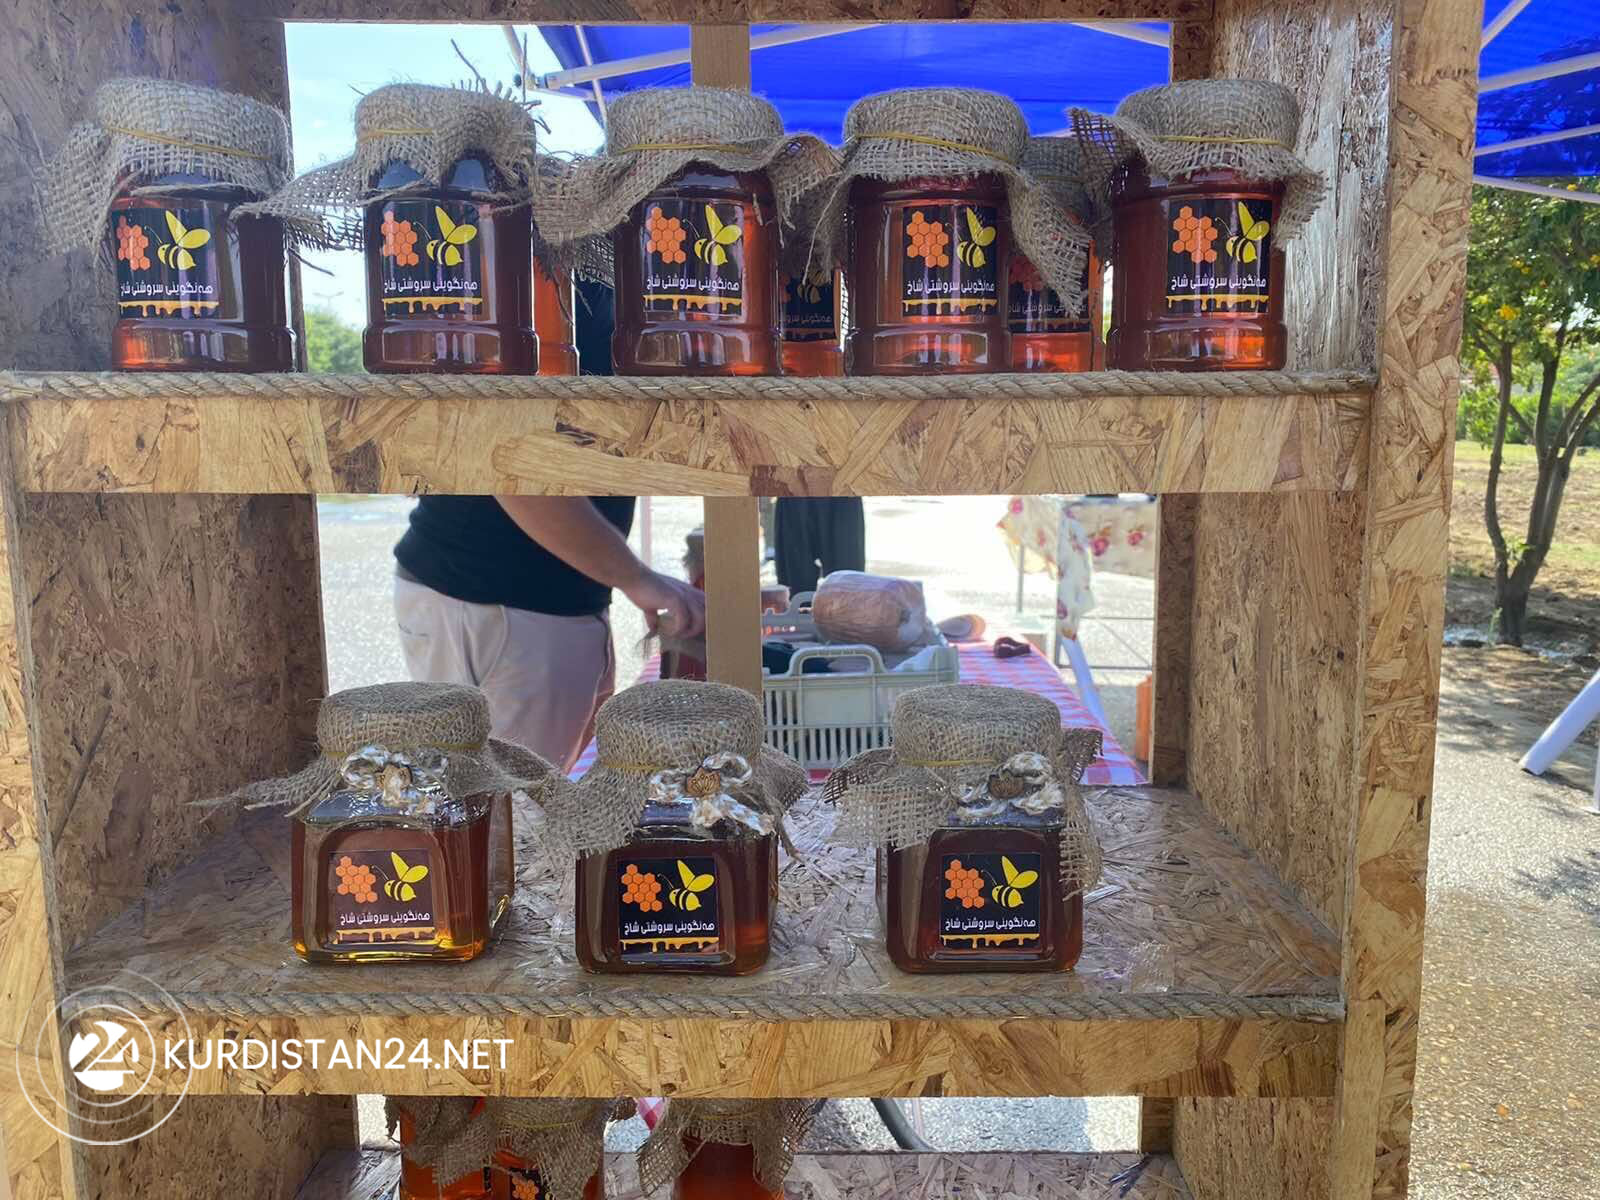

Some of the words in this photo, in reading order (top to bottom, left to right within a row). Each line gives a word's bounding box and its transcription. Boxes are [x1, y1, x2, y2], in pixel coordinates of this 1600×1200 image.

[131, 280, 164, 296] سروشتی
[384, 277, 397, 294] شاخ
[397, 276, 432, 293] سروشتی
[646, 273, 661, 290] شاخ
[662, 273, 697, 290] سروشتی
[907, 277, 923, 295] شاخ
[925, 277, 961, 294] سروشتی
[1170, 273, 1188, 291] شاخ
[1189, 273, 1228, 290] سروشتی
[340, 911, 356, 926] شاخ
[357, 911, 390, 925] سروشتی
[945, 916, 961, 931] شاخ
[961, 916, 995, 931] سروشتی
[624, 920, 640, 936] شاخ
[640, 920, 674, 935] سروشتی
